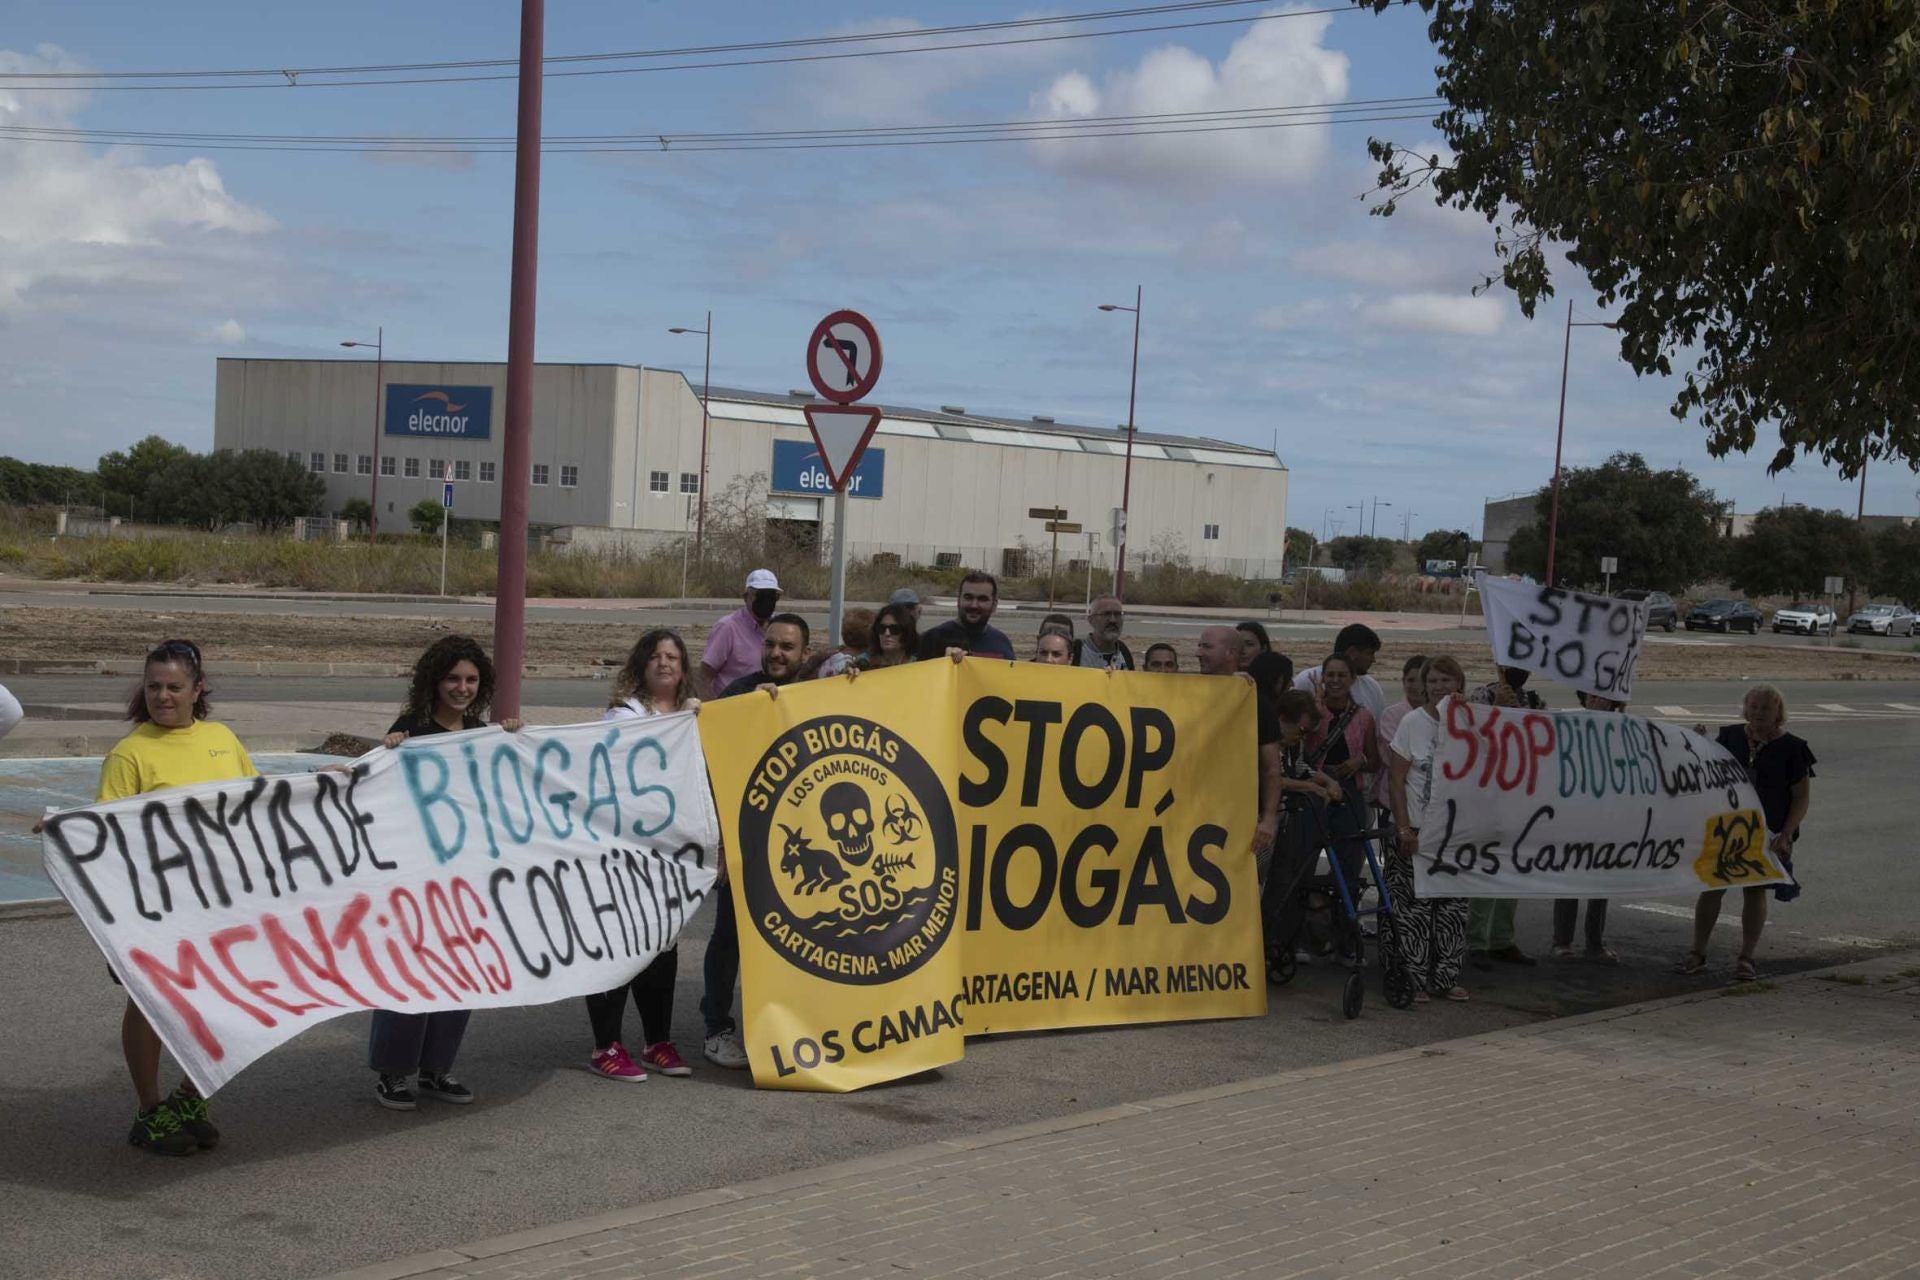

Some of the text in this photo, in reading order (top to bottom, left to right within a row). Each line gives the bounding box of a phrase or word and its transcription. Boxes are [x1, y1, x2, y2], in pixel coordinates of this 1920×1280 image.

[408, 408, 469, 433] elecnor
[799, 466, 863, 491] elecor
[748, 722, 900, 812] STOP BIOGÁS
[787, 760, 888, 808] LOS CAMACHOS
[958, 695, 1176, 810] STOP
[1443, 696, 1556, 796] STOP
[965, 788, 1231, 931] IOGÁS
[1427, 799, 1685, 876] Los Camachos
[838, 874, 904, 921] SOS
[921, 866, 957, 943] MENOR
[961, 970, 1080, 1005] ARTAGENA
[1105, 966, 1161, 997] MAR
[1166, 962, 1250, 994] MENOR
[770, 994, 964, 1078] LOS CAMAC
